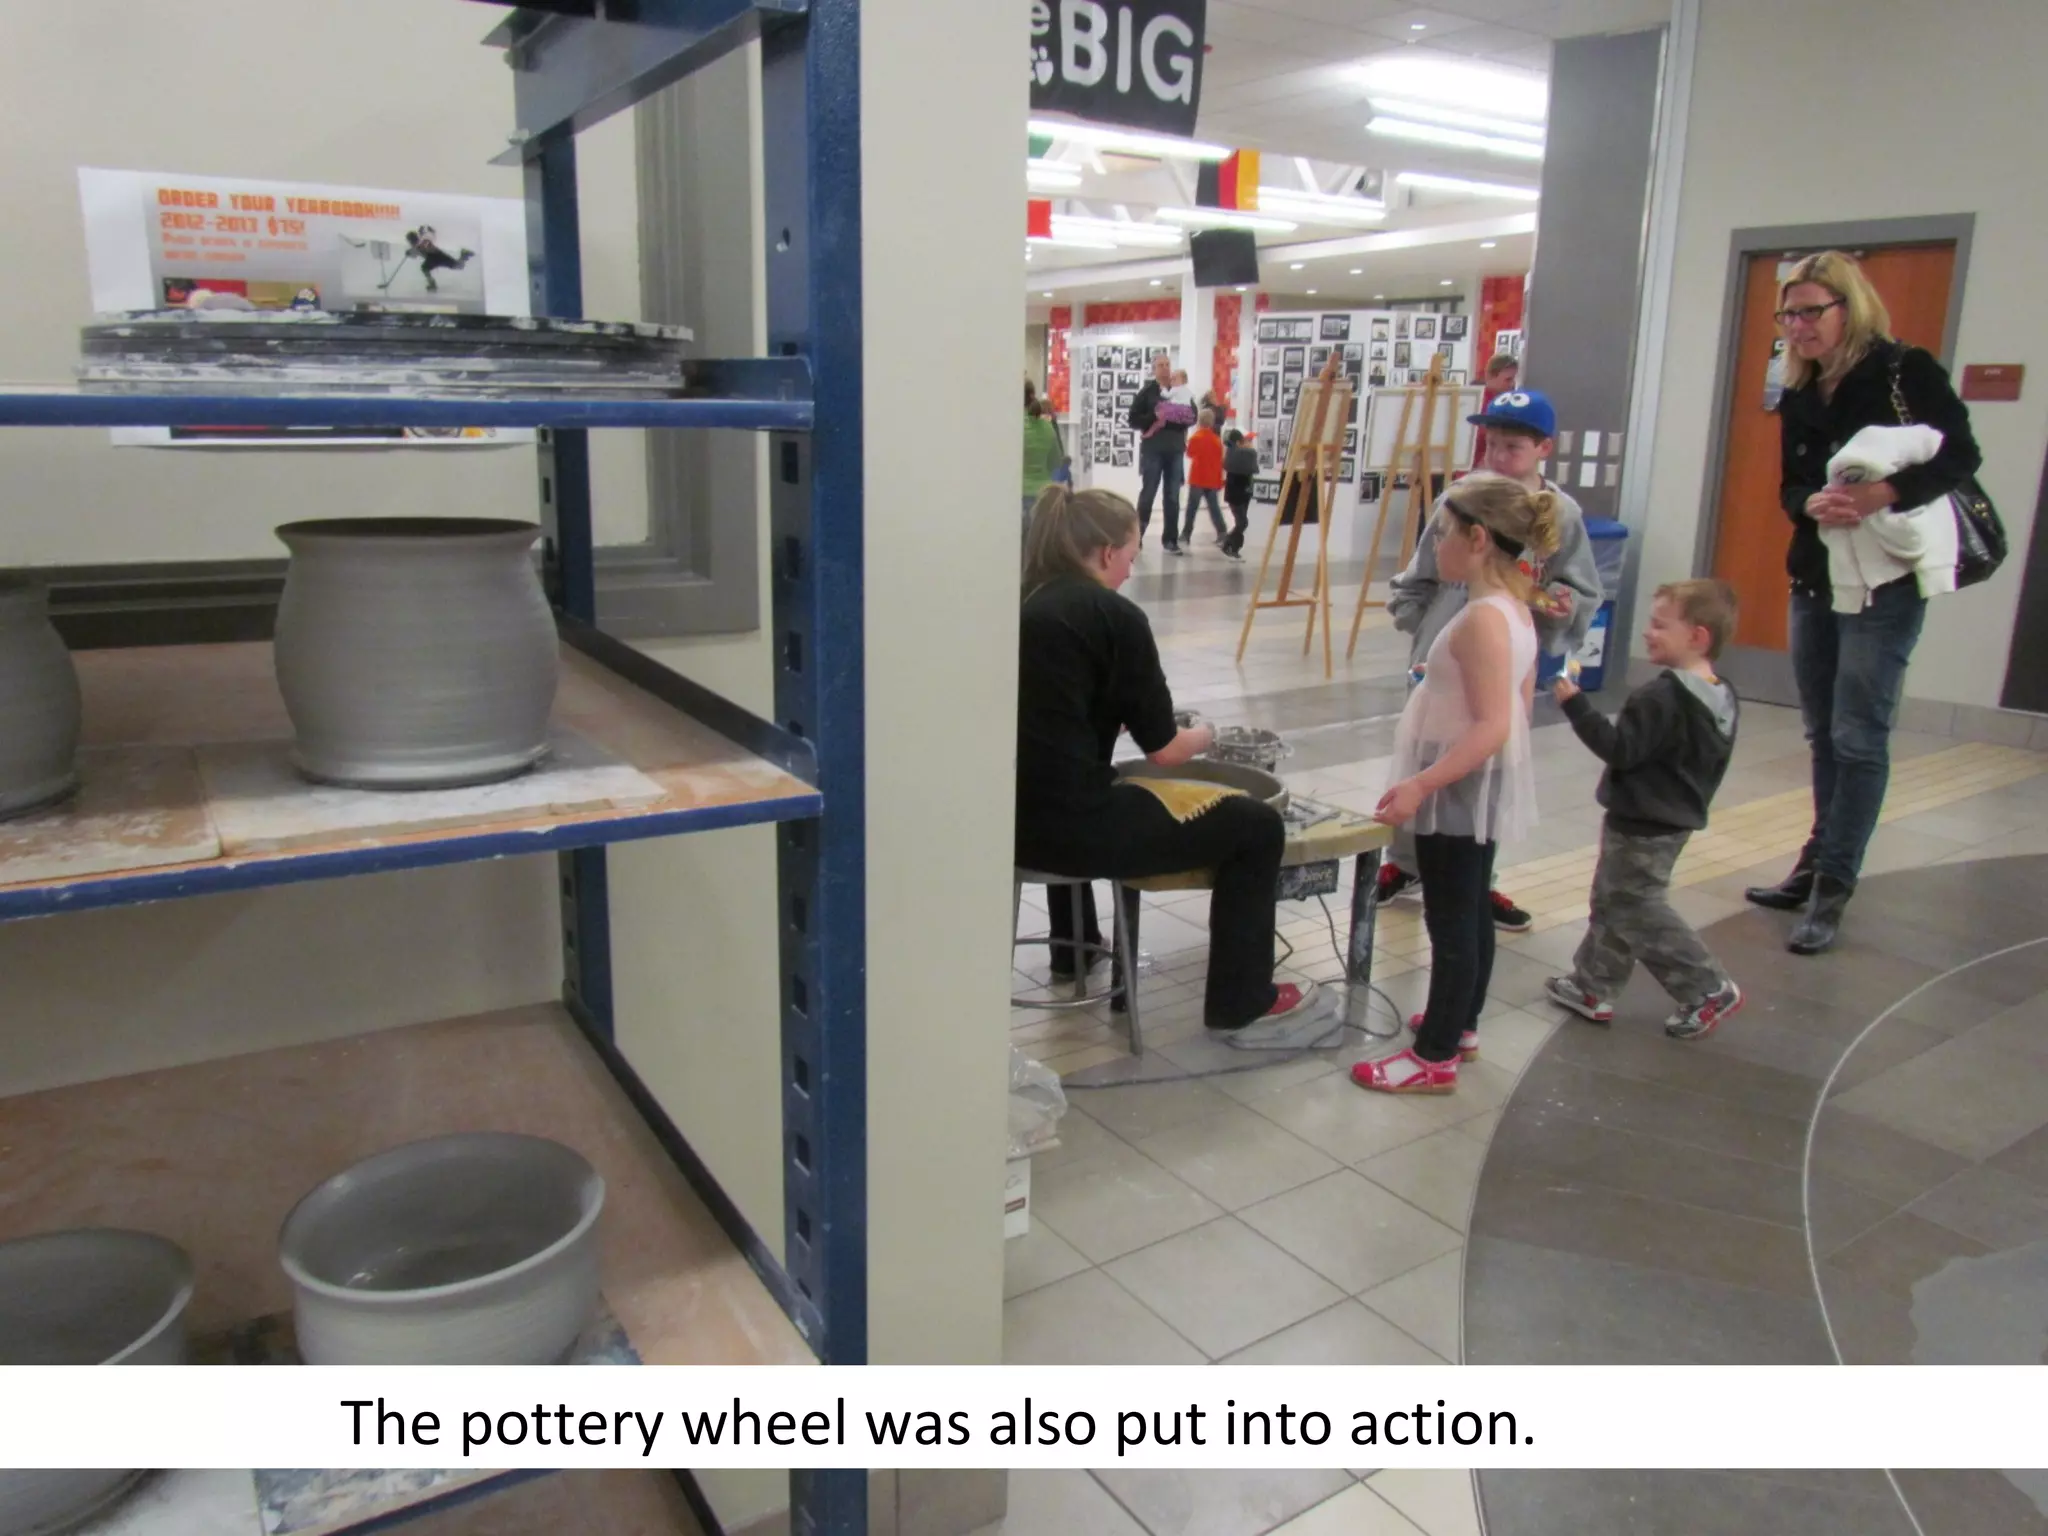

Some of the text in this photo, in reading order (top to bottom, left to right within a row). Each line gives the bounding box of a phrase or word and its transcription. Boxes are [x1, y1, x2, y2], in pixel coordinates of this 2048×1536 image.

[1059, 0, 1194, 105] BIG
[158, 188, 218, 208] ORDER
[230, 193, 275, 212] YOUR
